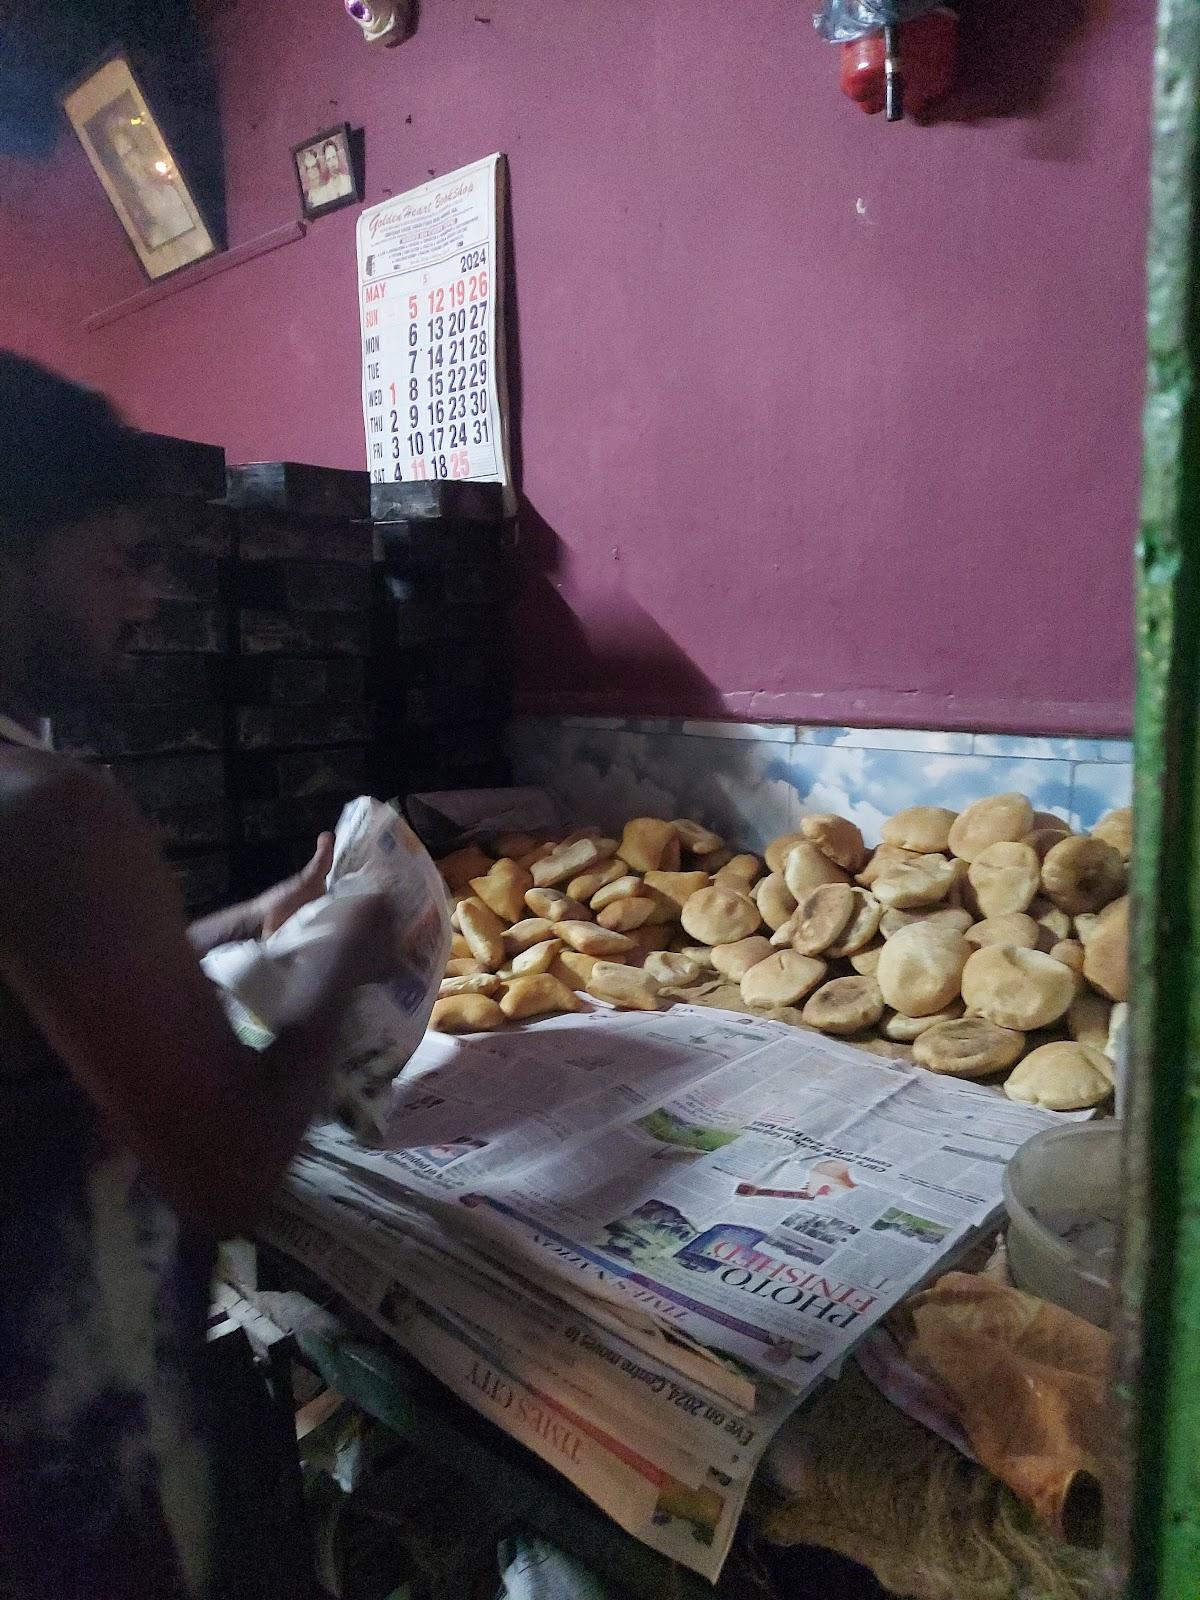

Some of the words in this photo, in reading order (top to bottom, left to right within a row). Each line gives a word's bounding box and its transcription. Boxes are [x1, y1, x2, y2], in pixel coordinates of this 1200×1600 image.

[369, 210, 402, 240] Golden
[403, 202, 432, 217] Heart
[435, 182, 474, 209] Bookshop
[460, 255, 487, 273] 2024
[365, 285, 386, 304] MAY
[365, 309, 378, 328] SUN
[408, 295, 418, 319] 5
[428, 290, 445, 313] 12
[449, 286, 465, 307] 19
[469, 271, 488, 301] 26
[365, 336, 380, 355] MON
[408, 323, 418, 346] 6
[428, 318, 444, 342] 13
[449, 313, 466, 337] 20
[470, 301, 488, 326] 27
[368, 362, 380, 380] TUE
[409, 350, 417, 374] 7
[428, 347, 444, 370] 14
[449, 341, 466, 365] 21
[470, 331, 487, 357] 28
[368, 387, 383, 407] WED
[390, 383, 397, 405] 1
[409, 378, 418, 401] 8
[428, 374, 444, 397] 15
[448, 369, 467, 393] 22
[469, 360, 487, 385] 29
[370, 414, 383, 434] THU
[390, 410, 399, 433] 2
[409, 405, 419, 428] 9
[428, 401, 444, 425] 16
[449, 397, 467, 419] 23
[470, 389, 487, 415] 30
[373, 442, 383, 459] FRI
[392, 436, 400, 458] 3
[408, 431, 424, 456] 10
[429, 428, 445, 452] 17
[449, 423, 467, 447] 24
[473, 417, 489, 444] 31
[372, 468, 385, 483] SAT
[394, 462, 403, 482] 4
[411, 458, 426, 482] 11
[431, 454, 448, 480] 18
[450, 451, 470, 478] 25
[711, 1240, 878, 1314] FINISHED
[718, 1266, 861, 1330] PHOTO
[581, 1332, 622, 1365] moves
[466, 1363, 515, 1410] CITY
[619, 1359, 666, 1393] Centre
[665, 1382, 702, 1415] 2024,
[516, 1399, 584, 1465] TIMES
[703, 1405, 725, 1426] on
